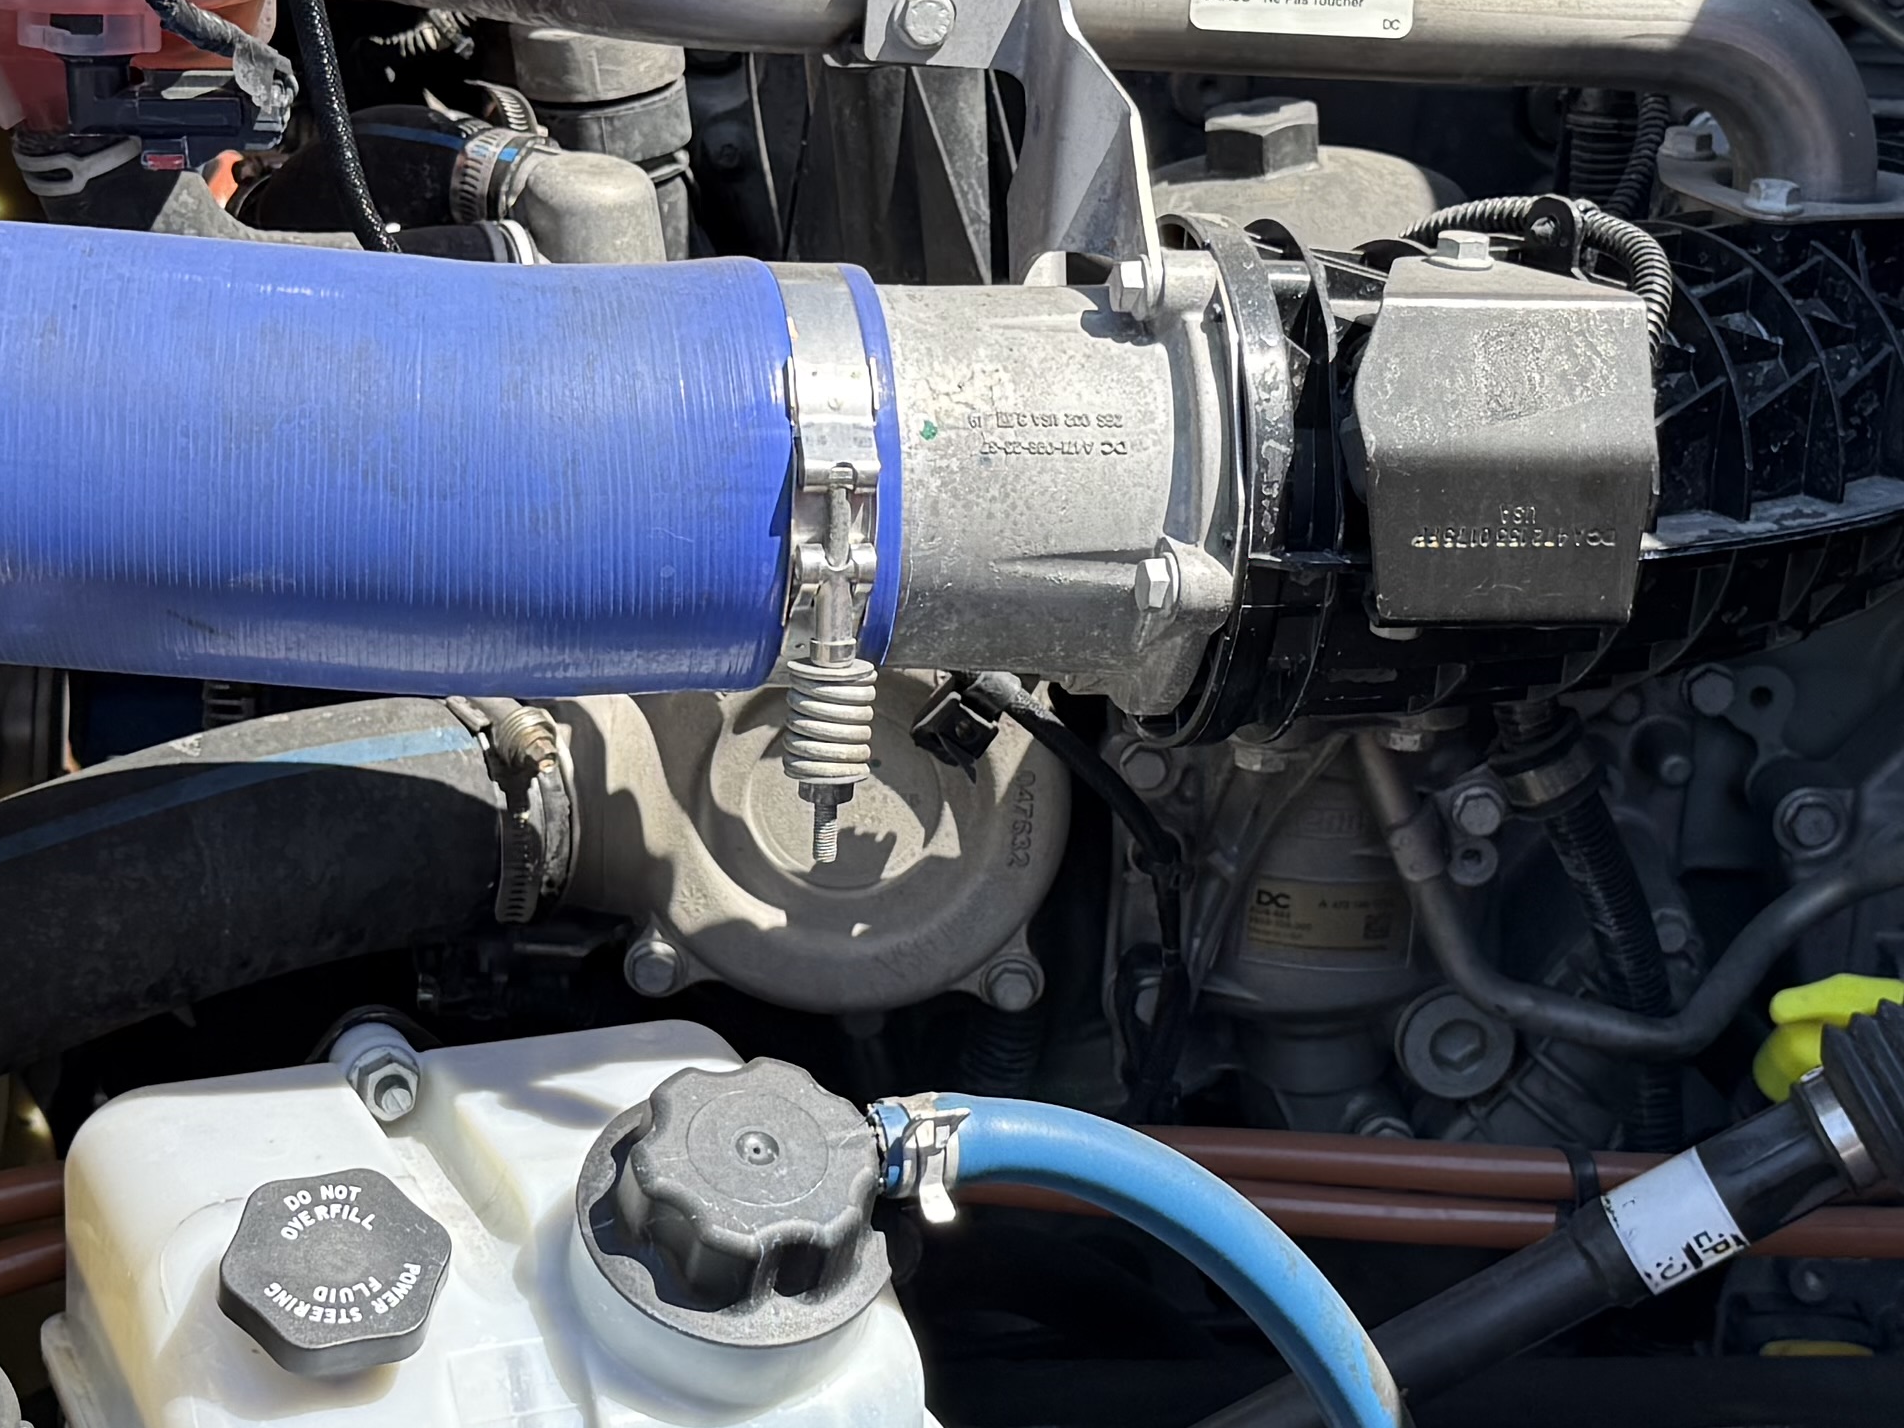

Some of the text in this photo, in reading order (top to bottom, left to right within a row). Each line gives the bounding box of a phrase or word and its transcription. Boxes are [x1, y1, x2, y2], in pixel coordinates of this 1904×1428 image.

[1382, 18, 1401, 31] DC
[1100, 441, 1128, 455] DC
[1499, 504, 1536, 524] USA
[1256, 889, 1291, 909] DC
[283, 1184, 362, 1211] DO NOT
[281, 1203, 375, 1240] OVERFILL
[264, 1263, 421, 1324] POWER STEERING
[313, 1276, 382, 1303] FLUID
